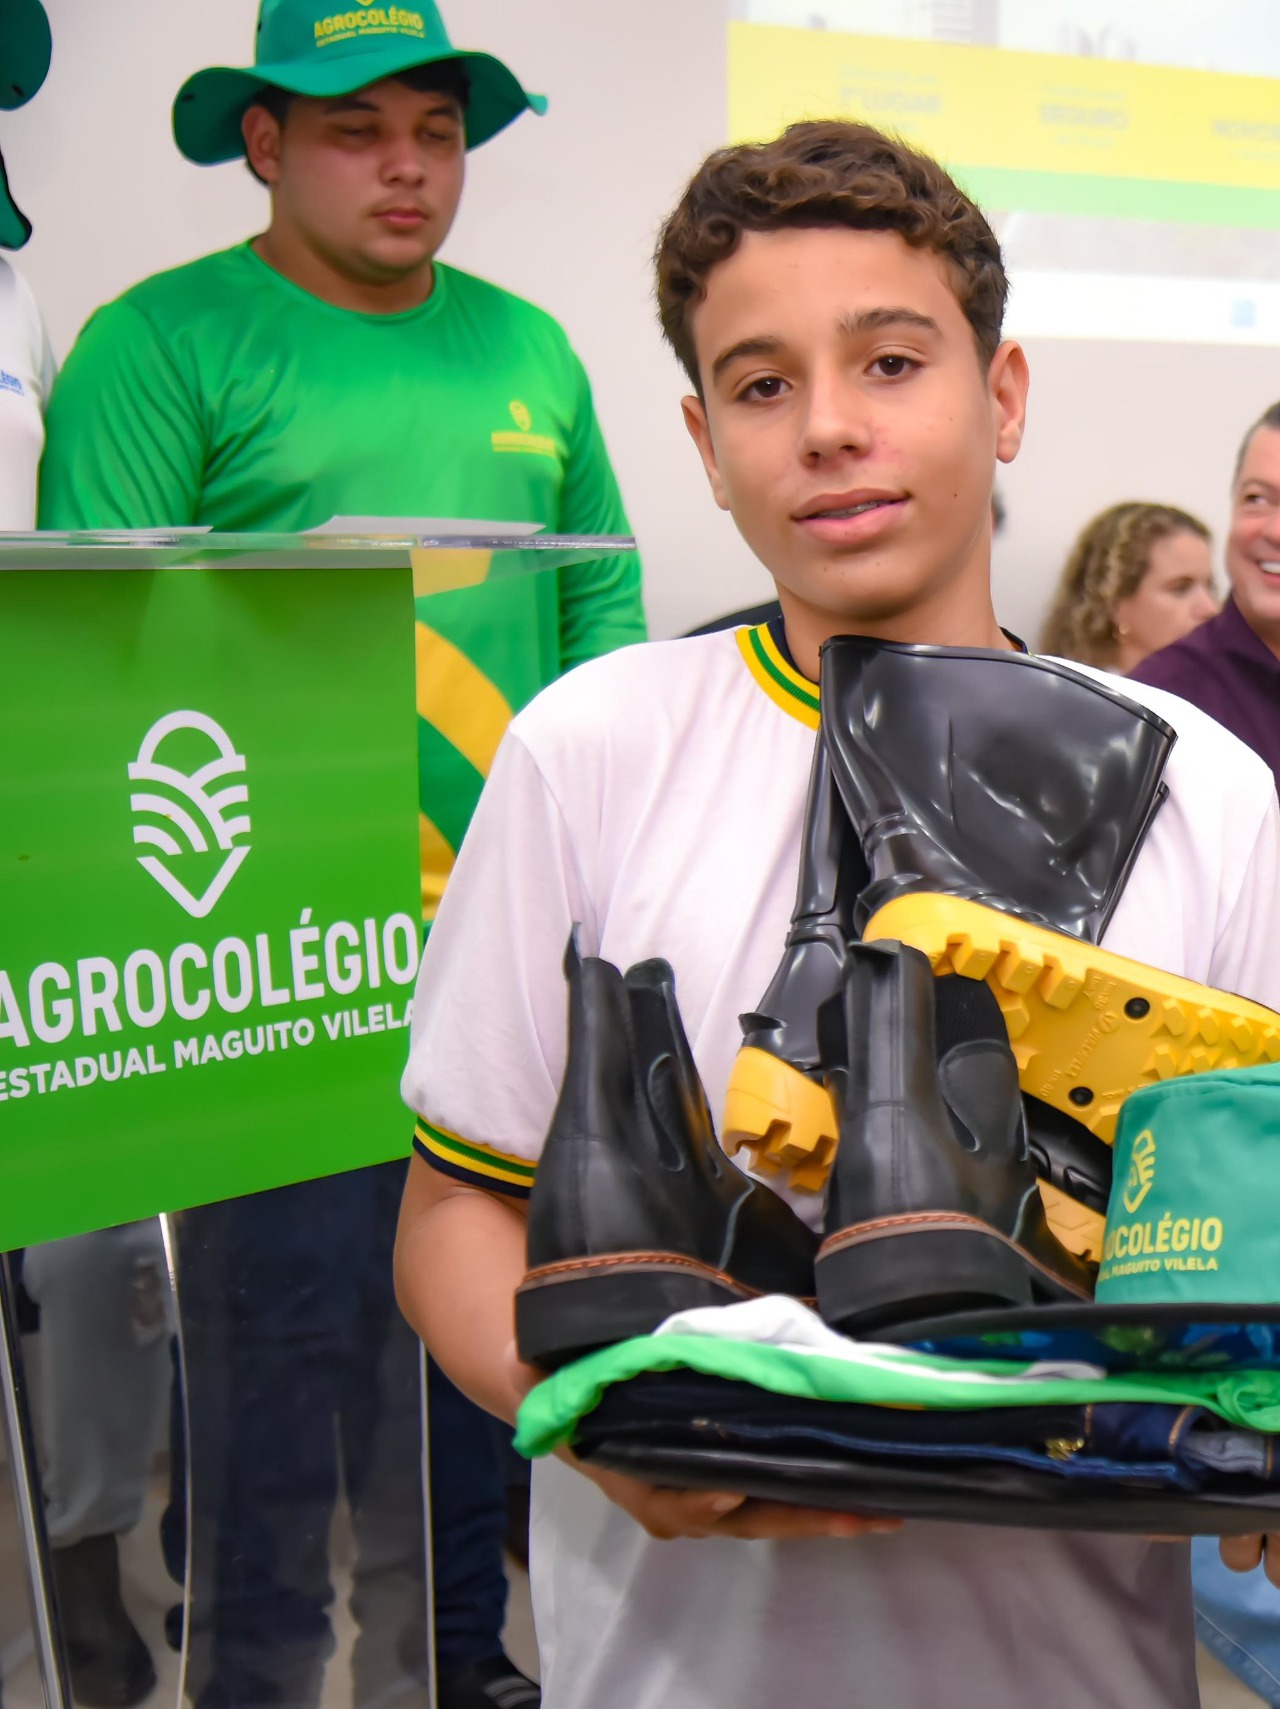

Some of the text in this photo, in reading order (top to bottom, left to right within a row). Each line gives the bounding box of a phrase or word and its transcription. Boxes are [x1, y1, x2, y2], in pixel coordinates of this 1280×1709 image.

[314, 6, 424, 38] AGROCOLÉGIO
[0, 908, 419, 1048] AGROCOLÉGIO
[174, 1018, 315, 1070] MAGUITO
[1112, 1258, 1161, 1277] MAGUITO
[1164, 1256, 1219, 1271] VILELA
